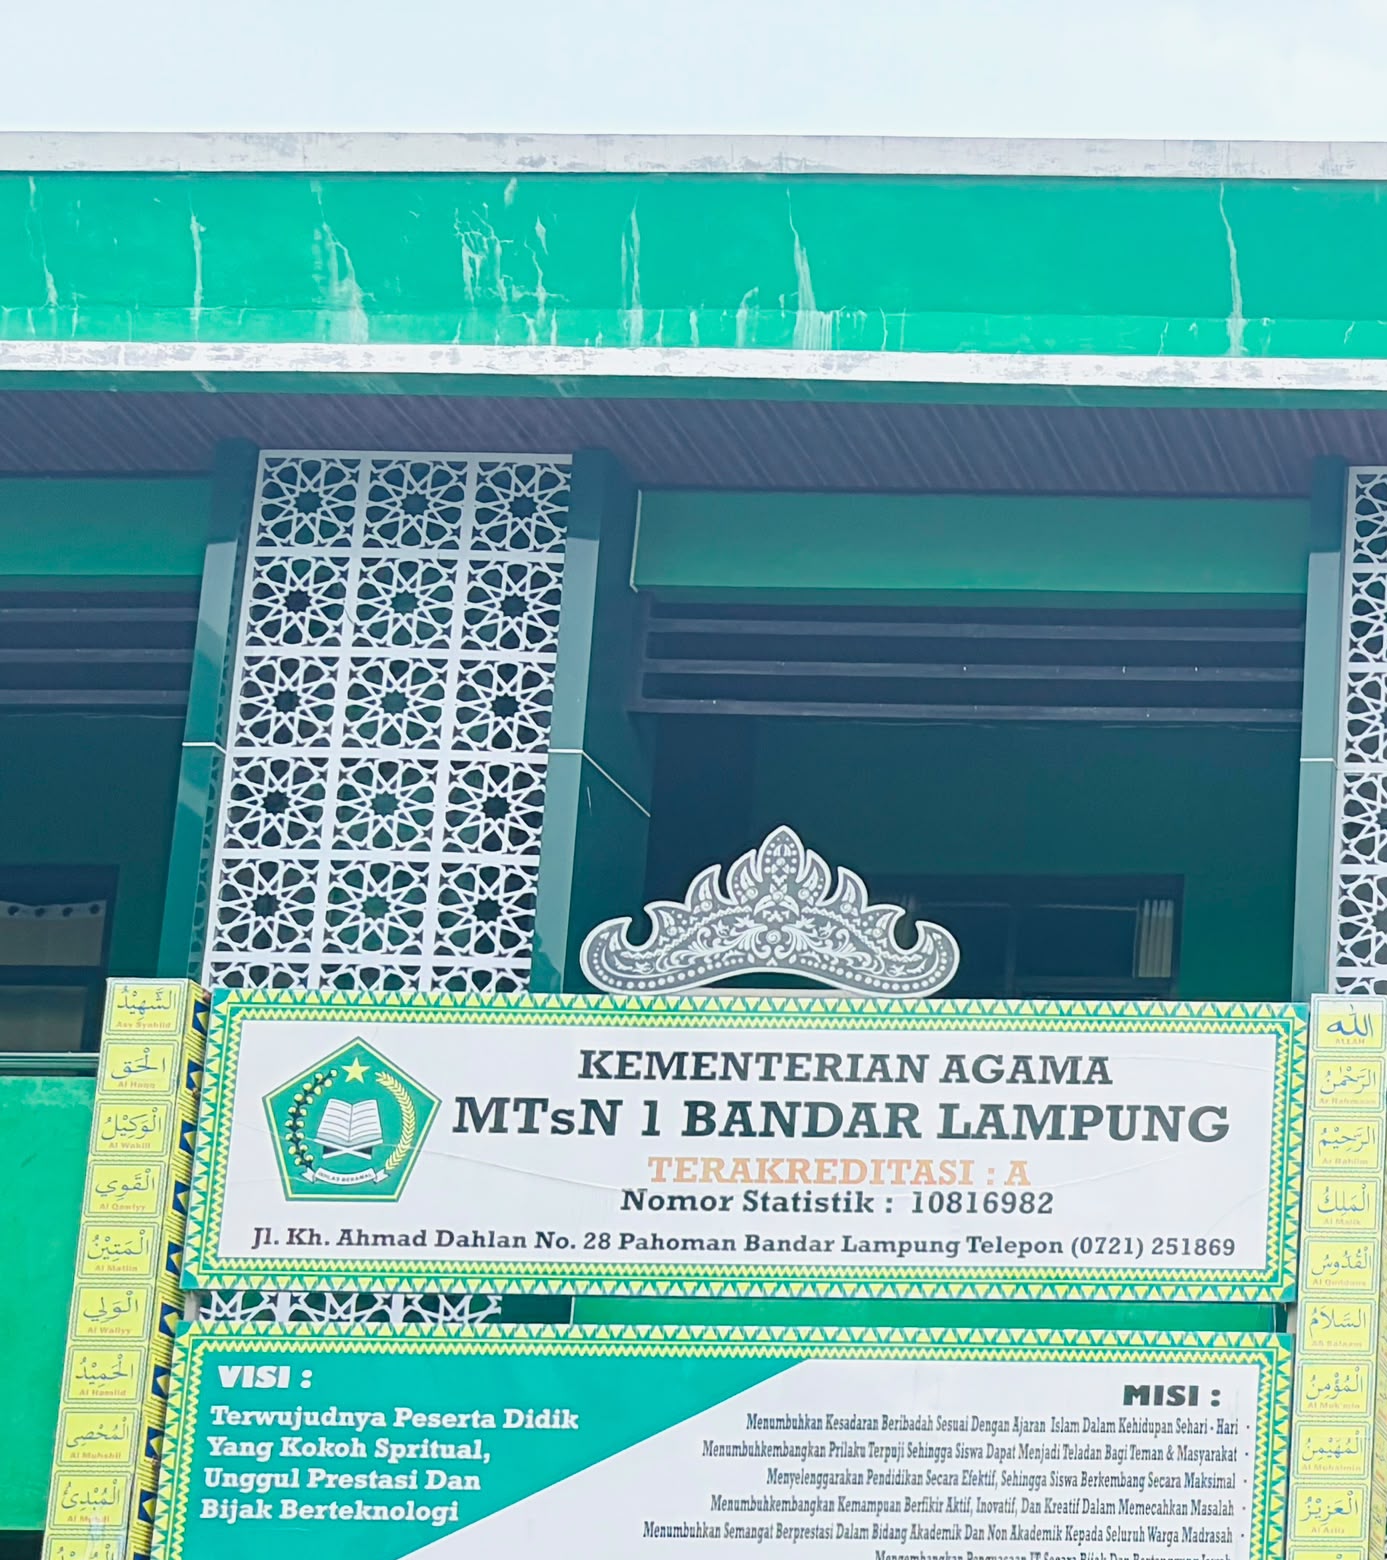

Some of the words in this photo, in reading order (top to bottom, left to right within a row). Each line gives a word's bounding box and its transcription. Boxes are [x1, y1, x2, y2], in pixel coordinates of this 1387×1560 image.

[577, 1049, 930, 1083] KEMENTERIAN
[938, 1053, 1113, 1085] AGAMA
[451, 1095, 624, 1136] MTsN
[640, 1099, 661, 1137] 1
[680, 1099, 922, 1139] BANDAR
[936, 1102, 1229, 1143] LAMPUNG
[647, 1156, 975, 1186] TERAKREDITASI
[1003, 1160, 1031, 1186] A
[619, 1187, 734, 1212] Nomor
[742, 1189, 874, 1213] Statistik
[911, 1190, 1053, 1214] 10816982
[250, 1226, 279, 1250] Jl.
[285, 1227, 330, 1246] Kh.
[335, 1228, 427, 1247] Ahmad
[433, 1228, 527, 1249] Dahlan
[533, 1230, 576, 1250] No.
[582, 1231, 611, 1250] 28
[617, 1232, 736, 1251] Pahoman
[743, 1233, 835, 1252] Bandar
[840, 1234, 961, 1259] Lampung
[965, 1235, 1064, 1259] Telepon
[1071, 1236, 1144, 1260] (0721)
[1151, 1236, 1235, 1256] 251869
[217, 1364, 291, 1389] VISI
[1122, 1384, 1199, 1407] MISI
[209, 1404, 387, 1432] Terwujudnya
[392, 1406, 497, 1429] Peserta
[502, 1407, 579, 1430] Didik
[745, 1412, 823, 1431] Menumbuhkan
[824, 1412, 879, 1431] Kesadaran
[880, 1413, 933, 1432] Beribadah
[935, 1414, 969, 1432] Sesuai
[970, 1414, 1010, 1437] Dengan
[1011, 1415, 1046, 1437] Ajaran
[1050, 1415, 1080, 1433] Islam
[1081, 1416, 1116, 1434] Dalam
[1117, 1416, 1174, 1439] Kehidupan
[1175, 1416, 1208, 1435] Sehari
[1215, 1417, 1239, 1435] Hari
[206, 1435, 274, 1463] Yang
[278, 1436, 368, 1458] Kokoh
[373, 1437, 490, 1464] Spritual,
[203, 1467, 300, 1494] Unggul
[305, 1467, 418, 1490] Prestasi
[423, 1469, 481, 1491] Dan
[766, 1467, 864, 1490] Menyelenggarakan
[865, 1468, 923, 1486] Pendidikan
[925, 1468, 959, 1486] Secara
[960, 1468, 998, 1488] Efektif,
[1000, 1469, 1047, 1492] Sehingga
[1049, 1470, 1078, 1488] Siswa
[1079, 1470, 1146, 1493] Berkembang
[1147, 1470, 1182, 1489] Secara
[1183, 1471, 1236, 1489] Maksimal
[199, 1498, 273, 1525] Bijak
[278, 1498, 459, 1527] Berteknologi
[642, 1520, 721, 1539] Menumbuhkan
[723, 1521, 774, 1544] Semangat
[775, 1521, 833, 1544] Berprestasi
[835, 1522, 869, 1540] Dalam
[871, 1522, 908, 1545] Bidang
[909, 1522, 962, 1541] Akademik
[963, 1523, 985, 1541] Dan
[986, 1523, 1008, 1541] Non
[1009, 1523, 1063, 1542] Akademik
[1064, 1524, 1103, 1547] Kepada
[1105, 1524, 1145, 1543] Seluruh
[1146, 1525, 1179, 1548] Warga
[1181, 1525, 1233, 1544] Madrasah
